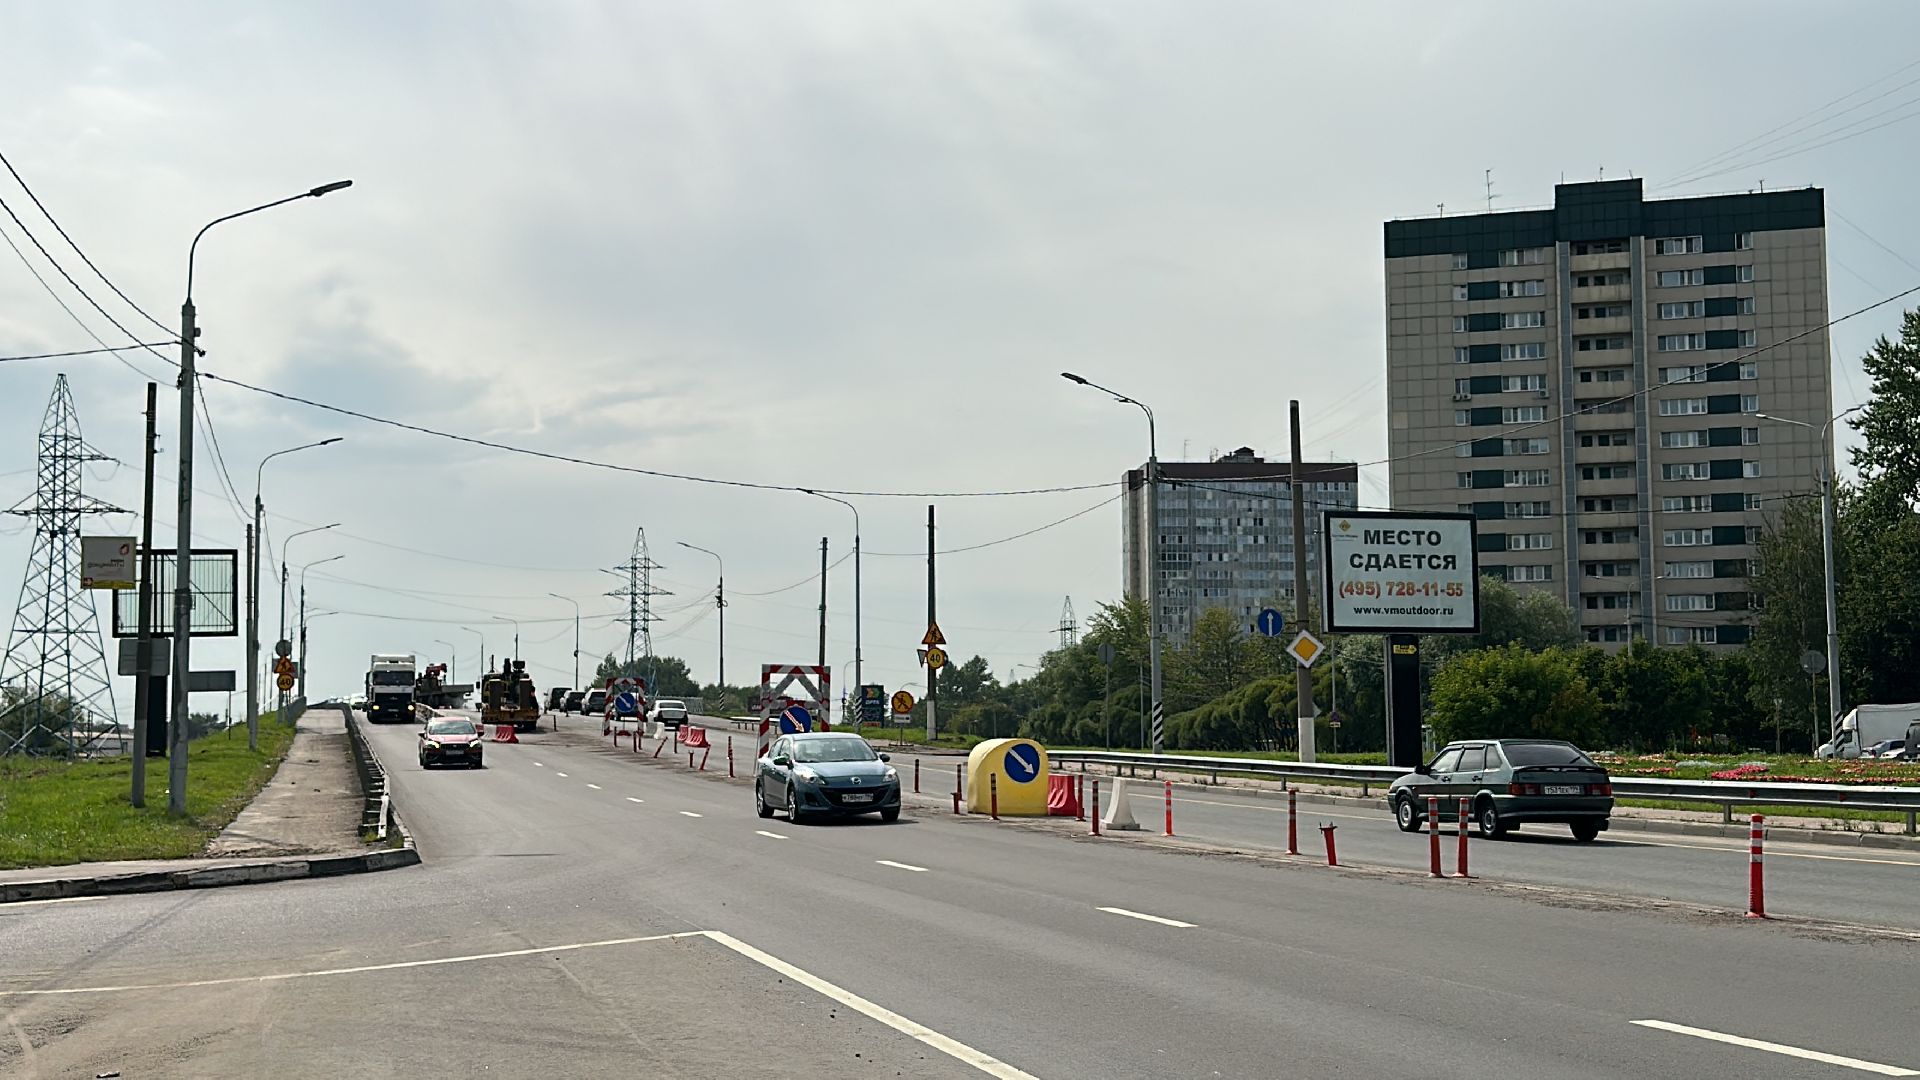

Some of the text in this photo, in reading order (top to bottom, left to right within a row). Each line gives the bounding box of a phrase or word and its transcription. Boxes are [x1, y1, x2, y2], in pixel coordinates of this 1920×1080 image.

[1364, 530, 1442, 546] МЕСТО
[1349, 553, 1457, 571] СДАЕТСЯ
[1339, 581, 1464, 598] (495) 728-11-55
[1354, 606, 1453, 615] www.vmoutdoor.ru
[930, 653, 941, 663] 40
[279, 678, 291, 686] 40
